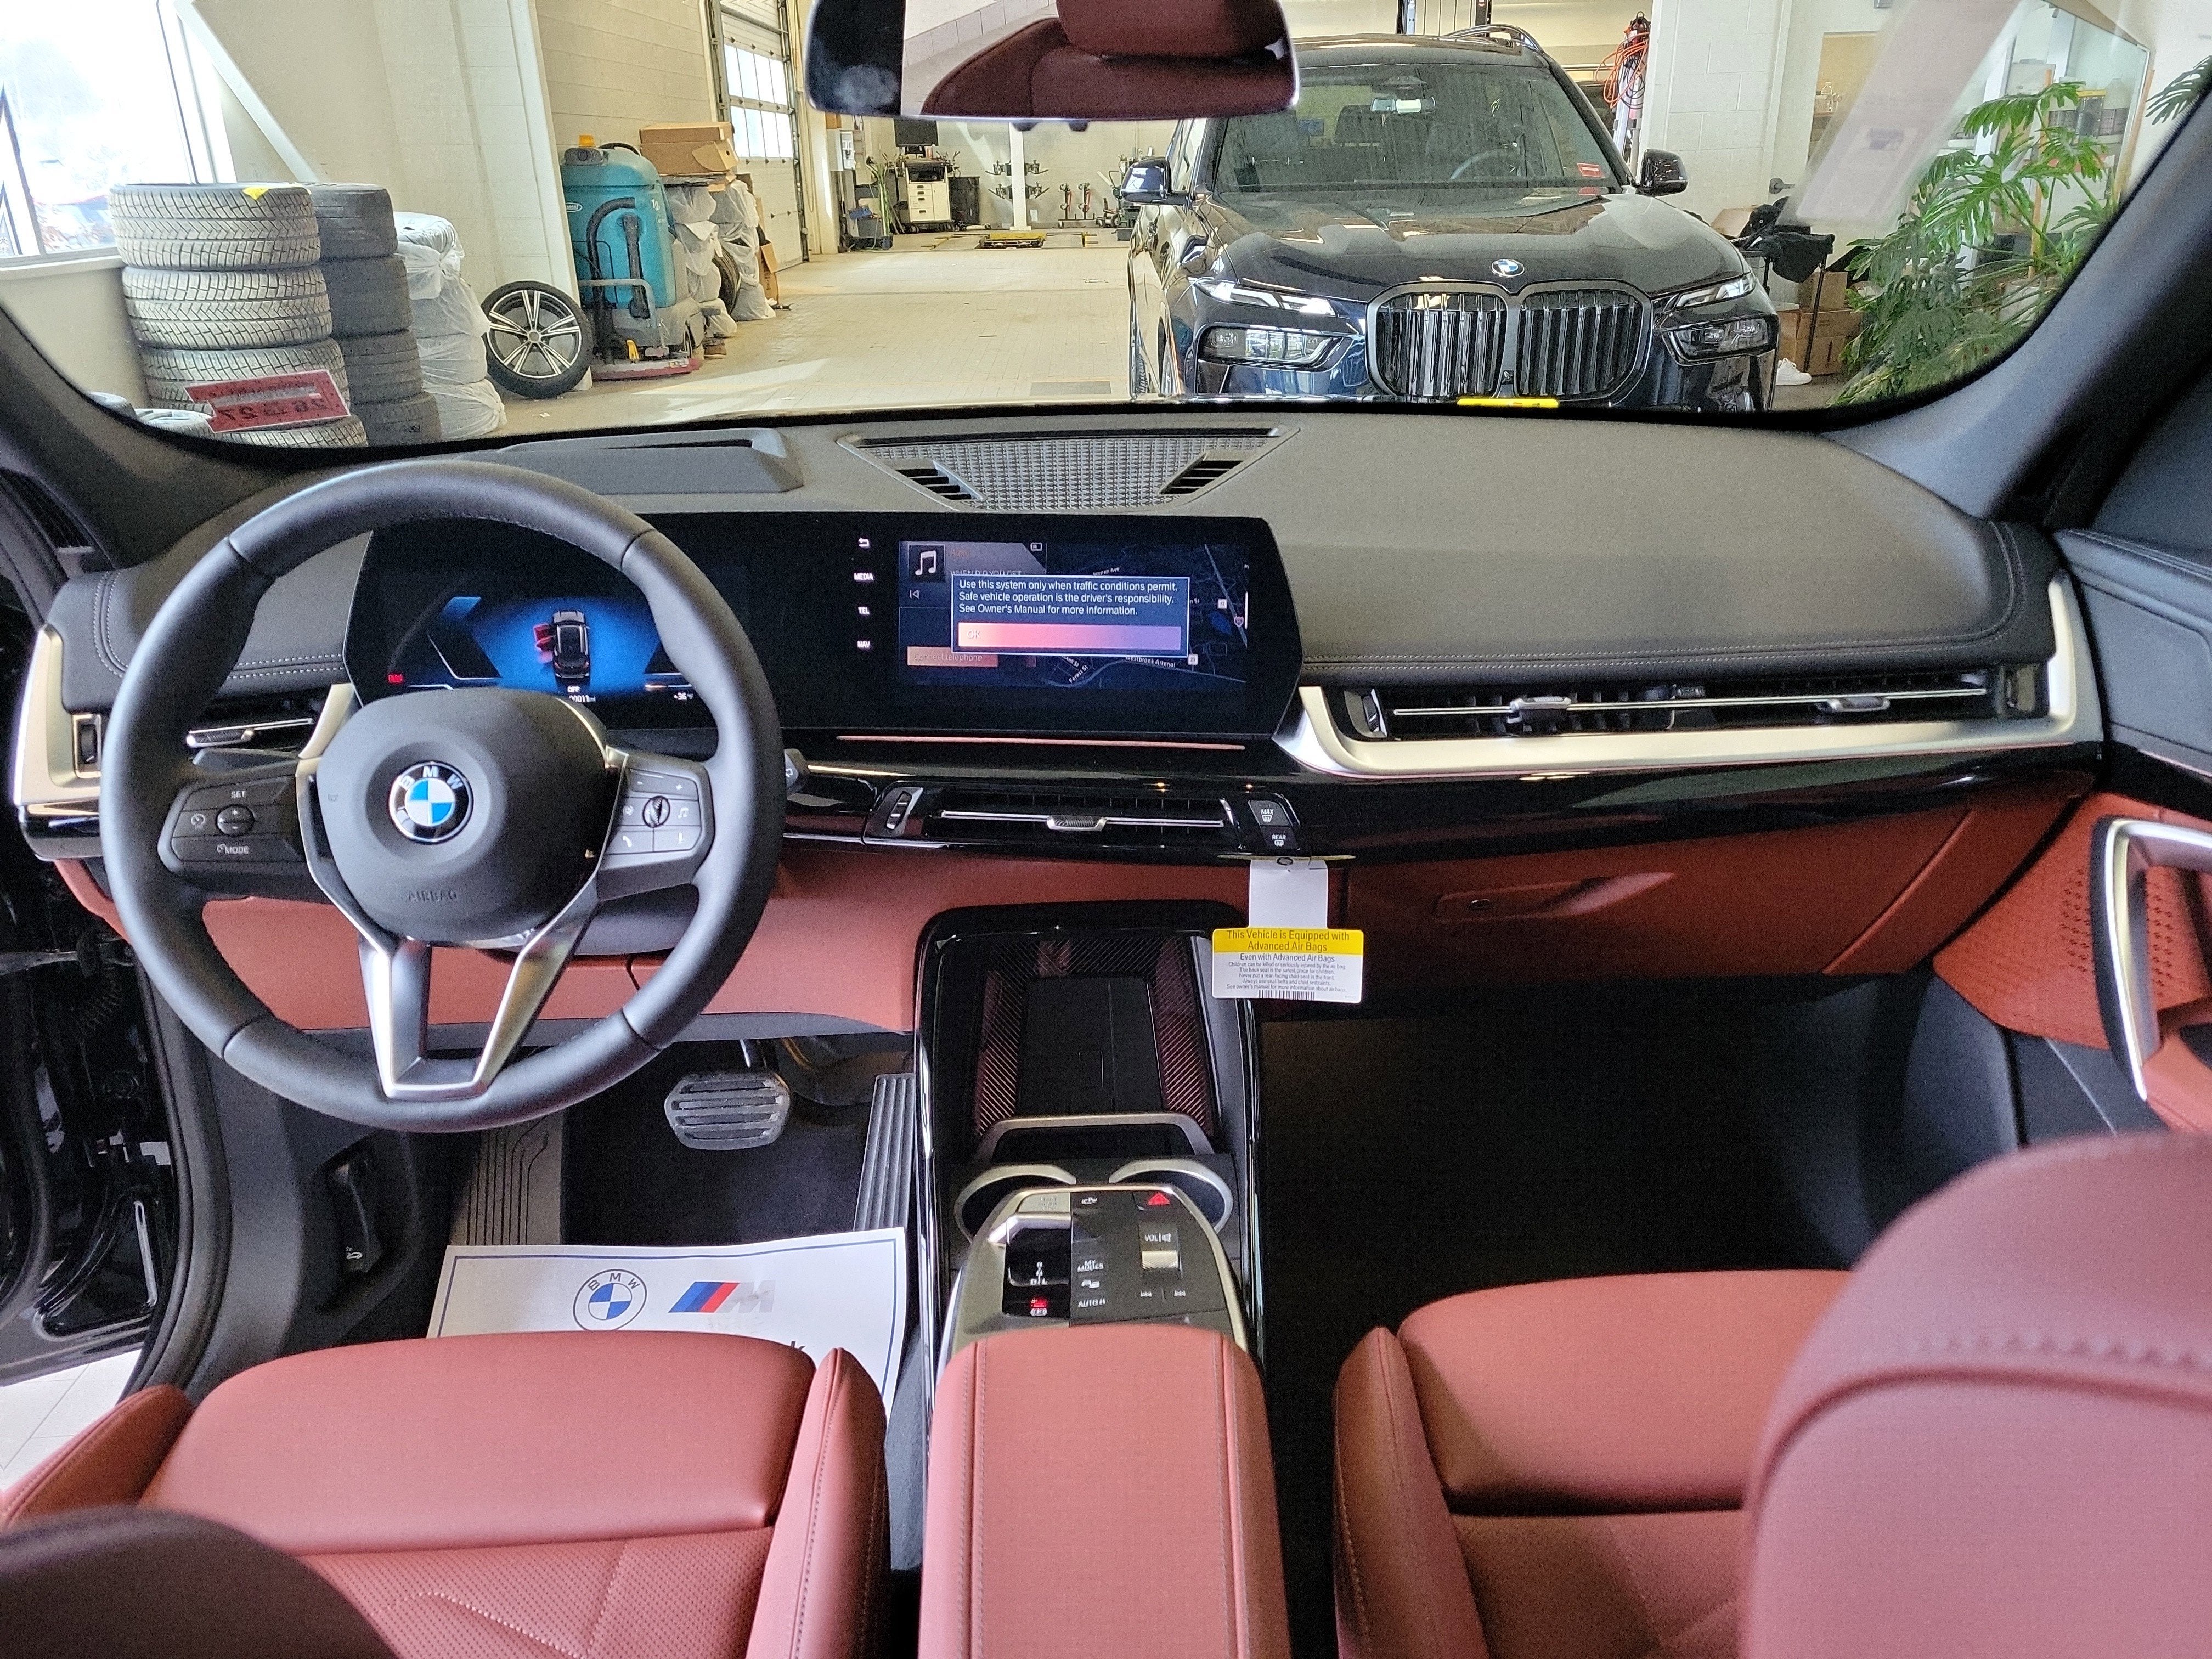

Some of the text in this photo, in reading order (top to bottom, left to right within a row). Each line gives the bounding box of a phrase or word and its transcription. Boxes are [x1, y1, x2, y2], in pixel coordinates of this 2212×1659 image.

[854, 572, 874, 581] MEDIA
[960, 579, 1178, 593] Use this system only when traffic conditions permit.
[959, 591, 1174, 605] Safe vehicle operation is the driver's responsibility.
[858, 606, 870, 615] TEL
[959, 603, 1138, 615] See Owner's Manual for more information.
[967, 630, 981, 639] OK
[857, 640, 871, 648] NAV
[946, 653, 983, 662] telephone
[399, 765, 464, 790] BMW
[230, 790, 246, 798] SET
[224, 845, 250, 854] MODE
[408, 890, 458, 902] AIRBAG
[1227, 930, 1350, 941] This Vehicle is Equipped with
[1248, 941, 1327, 953] Advanced Air Bags
[1318, 955, 1335, 963] Bags
[1144, 1234, 1158, 1242] VOL
[587, 1272, 640, 1291] BMW
[1078, 1298, 1098, 1308] AUTO
